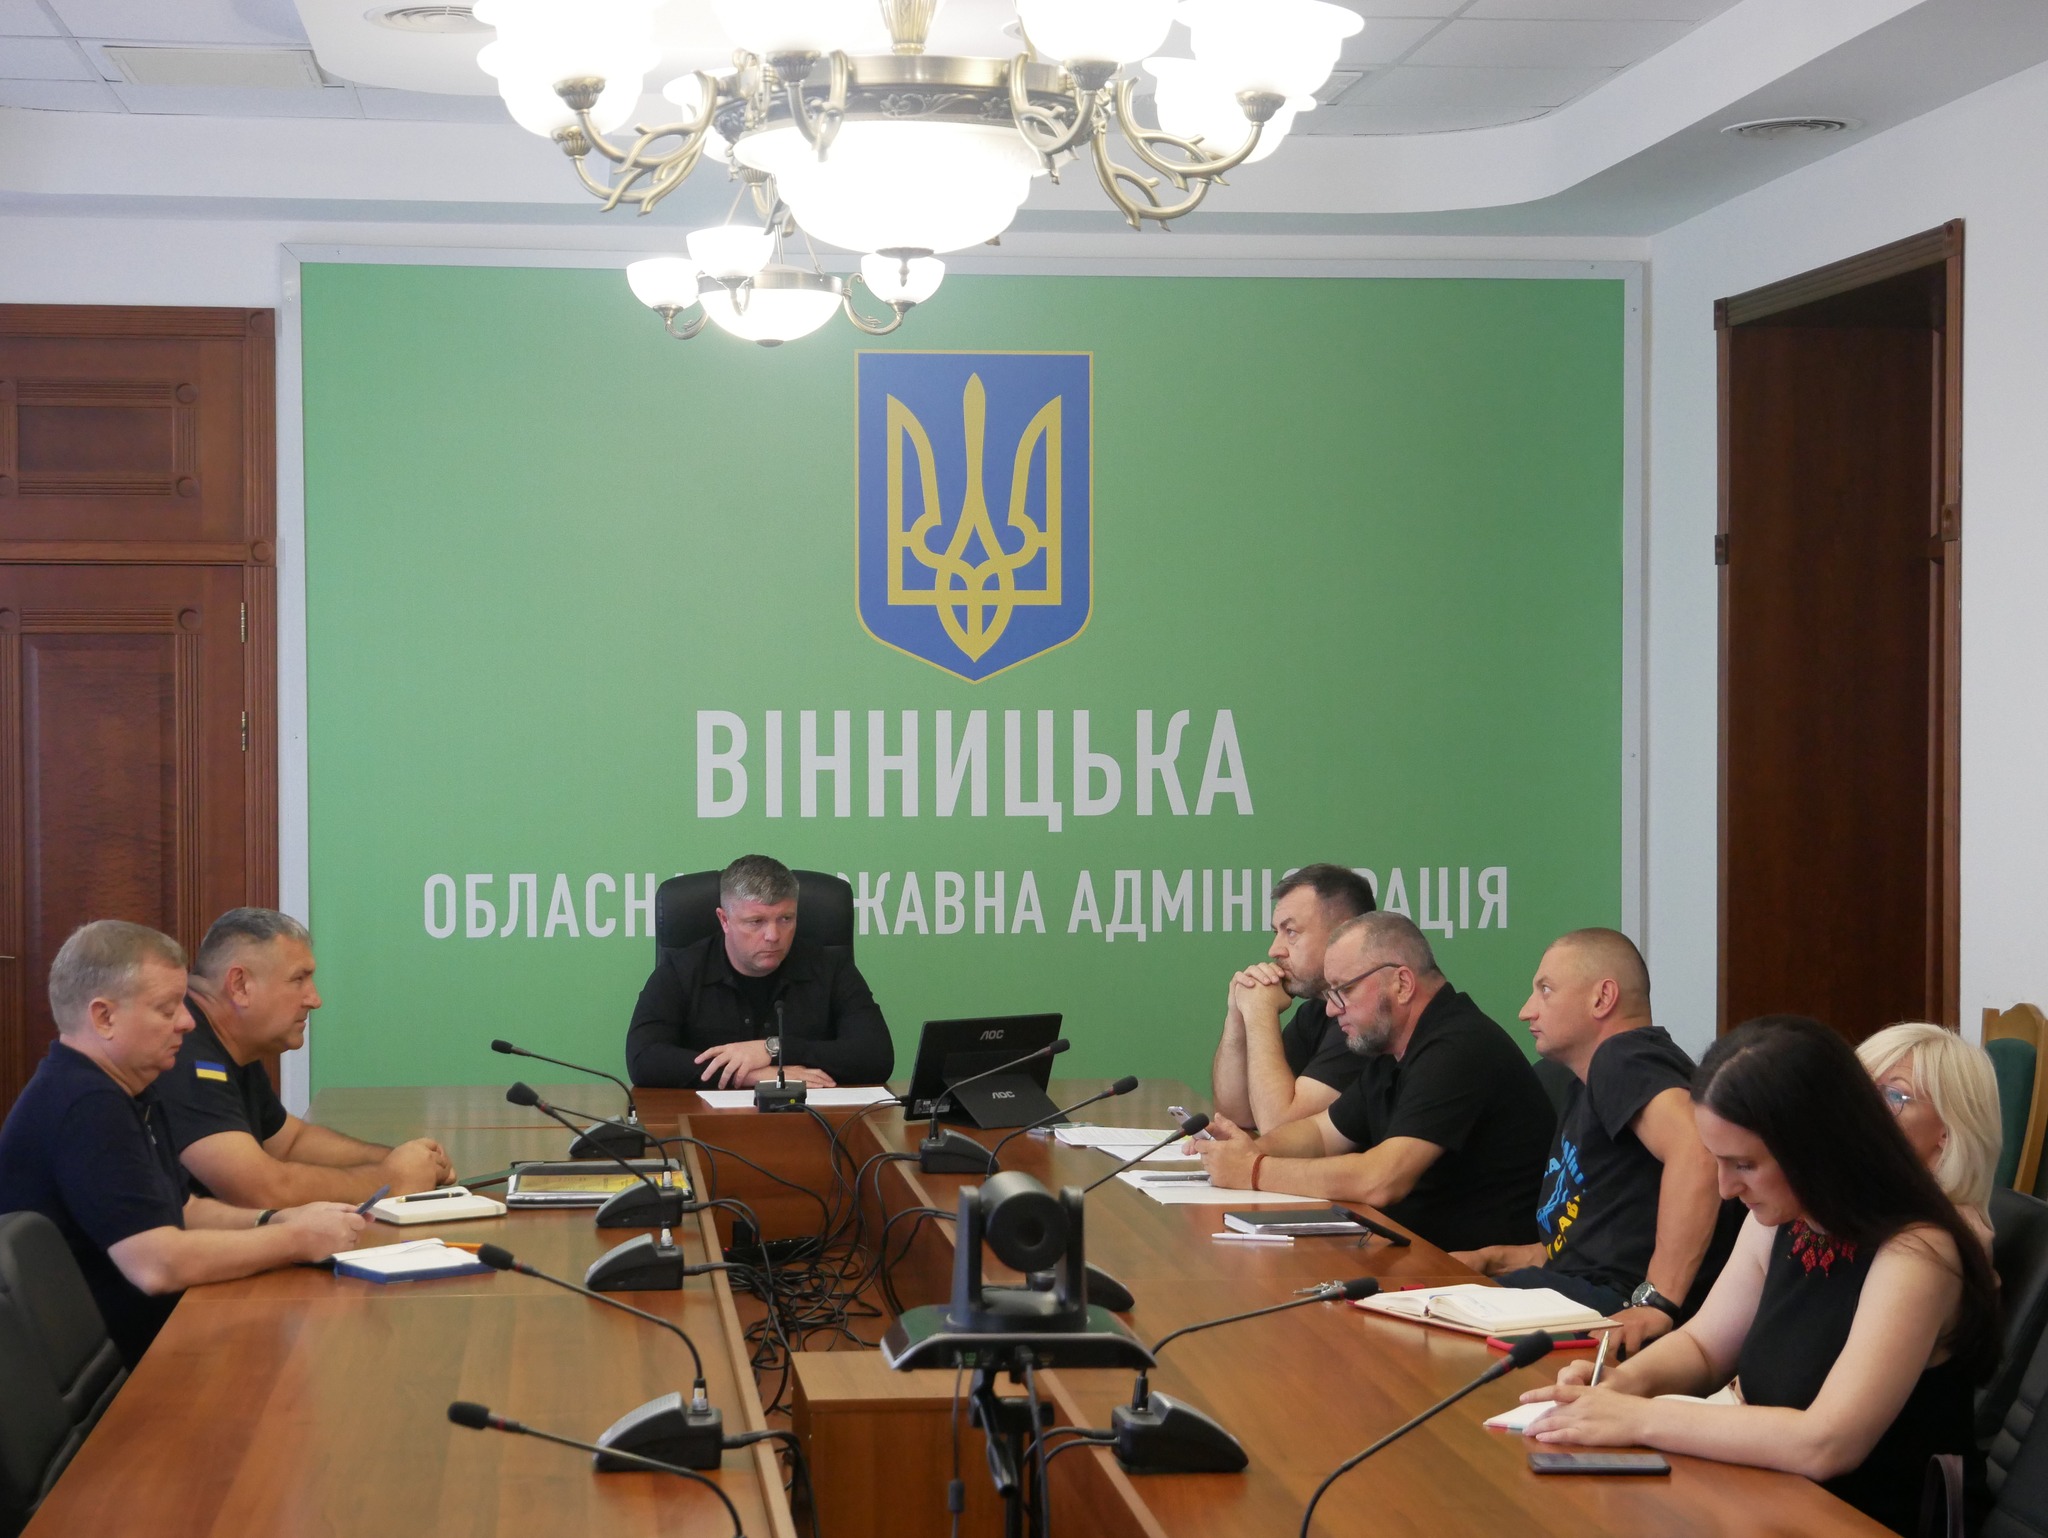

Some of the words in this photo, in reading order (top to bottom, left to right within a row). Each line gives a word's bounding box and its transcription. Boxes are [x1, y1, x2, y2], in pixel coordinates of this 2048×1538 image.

[696, 709, 1254, 832] ВІННИЦЬКА
[424, 873, 684, 938] ОБЛАСН
[1067, 866, 1508, 942] АДМІНІАЦІЯ
[980, 1029, 1005, 1041] AOC
